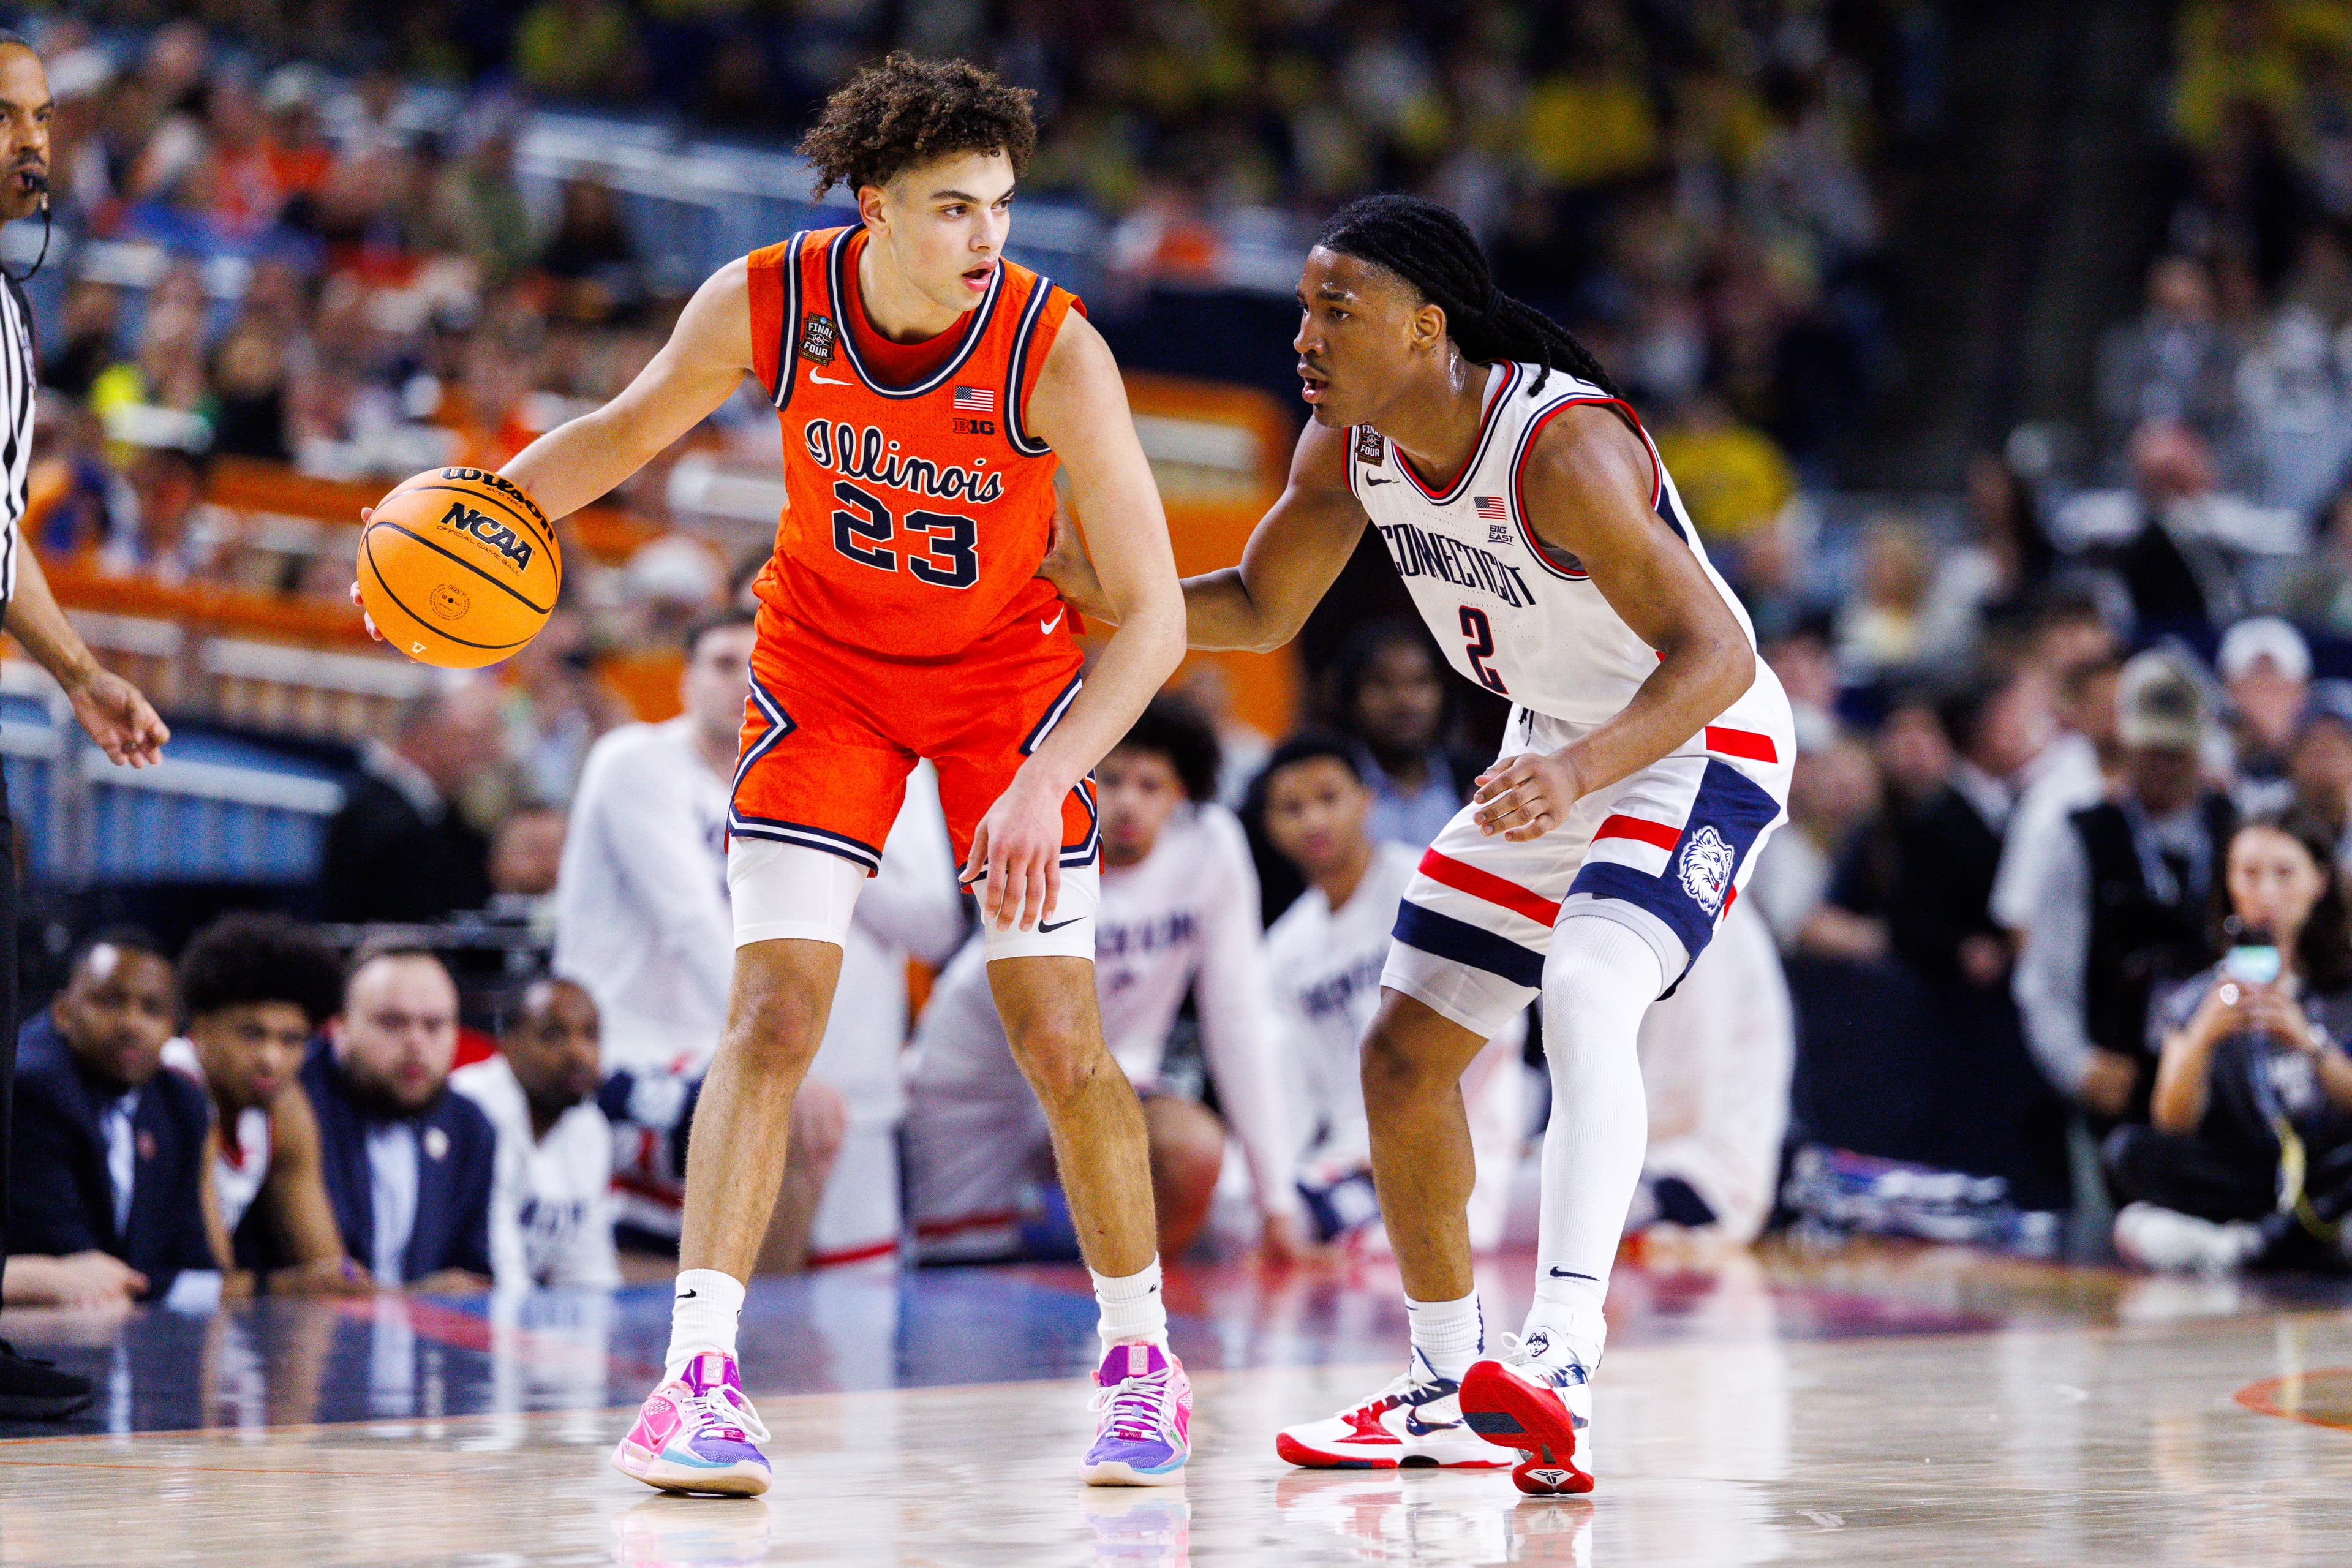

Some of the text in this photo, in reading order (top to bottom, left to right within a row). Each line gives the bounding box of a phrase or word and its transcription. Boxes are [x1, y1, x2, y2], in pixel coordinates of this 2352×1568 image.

[809, 322, 833, 339] FINAL
[804, 341, 828, 357] FOUR
[1360, 444, 1380, 457] FOUR
[804, 418, 1005, 504] Illinois
[486, 488, 523, 508] EVO NXT
[440, 502, 533, 572] NCAA
[832, 480, 980, 589] 23
[1489, 532, 1514, 542] EAST
[1490, 524, 1507, 534] BIG
[436, 525, 519, 576] OFFICIAL GAME BALL
[1459, 605, 1509, 695] 2
